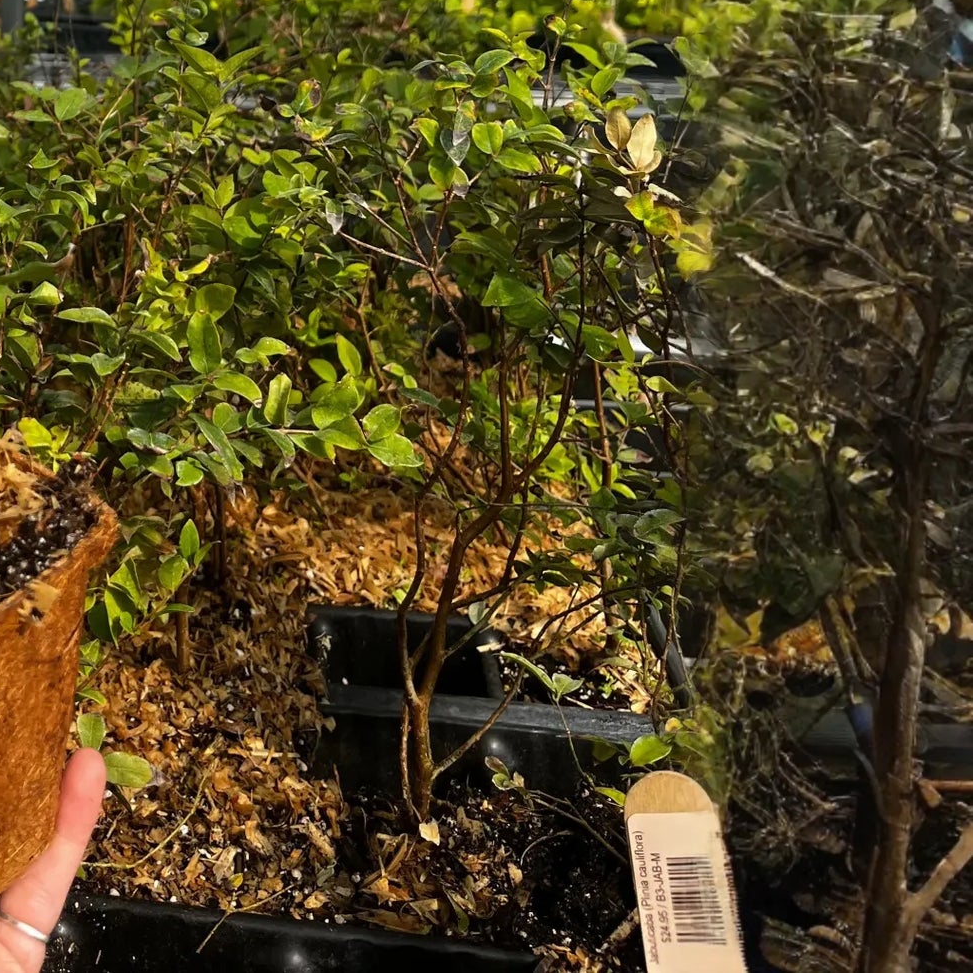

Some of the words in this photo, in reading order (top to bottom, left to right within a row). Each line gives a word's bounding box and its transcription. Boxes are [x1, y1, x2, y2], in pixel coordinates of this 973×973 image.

[632, 831, 647, 877] cauliflora)
[650, 853, 666, 901] B3-JAB-M
[658, 911, 671, 943] $24.95
